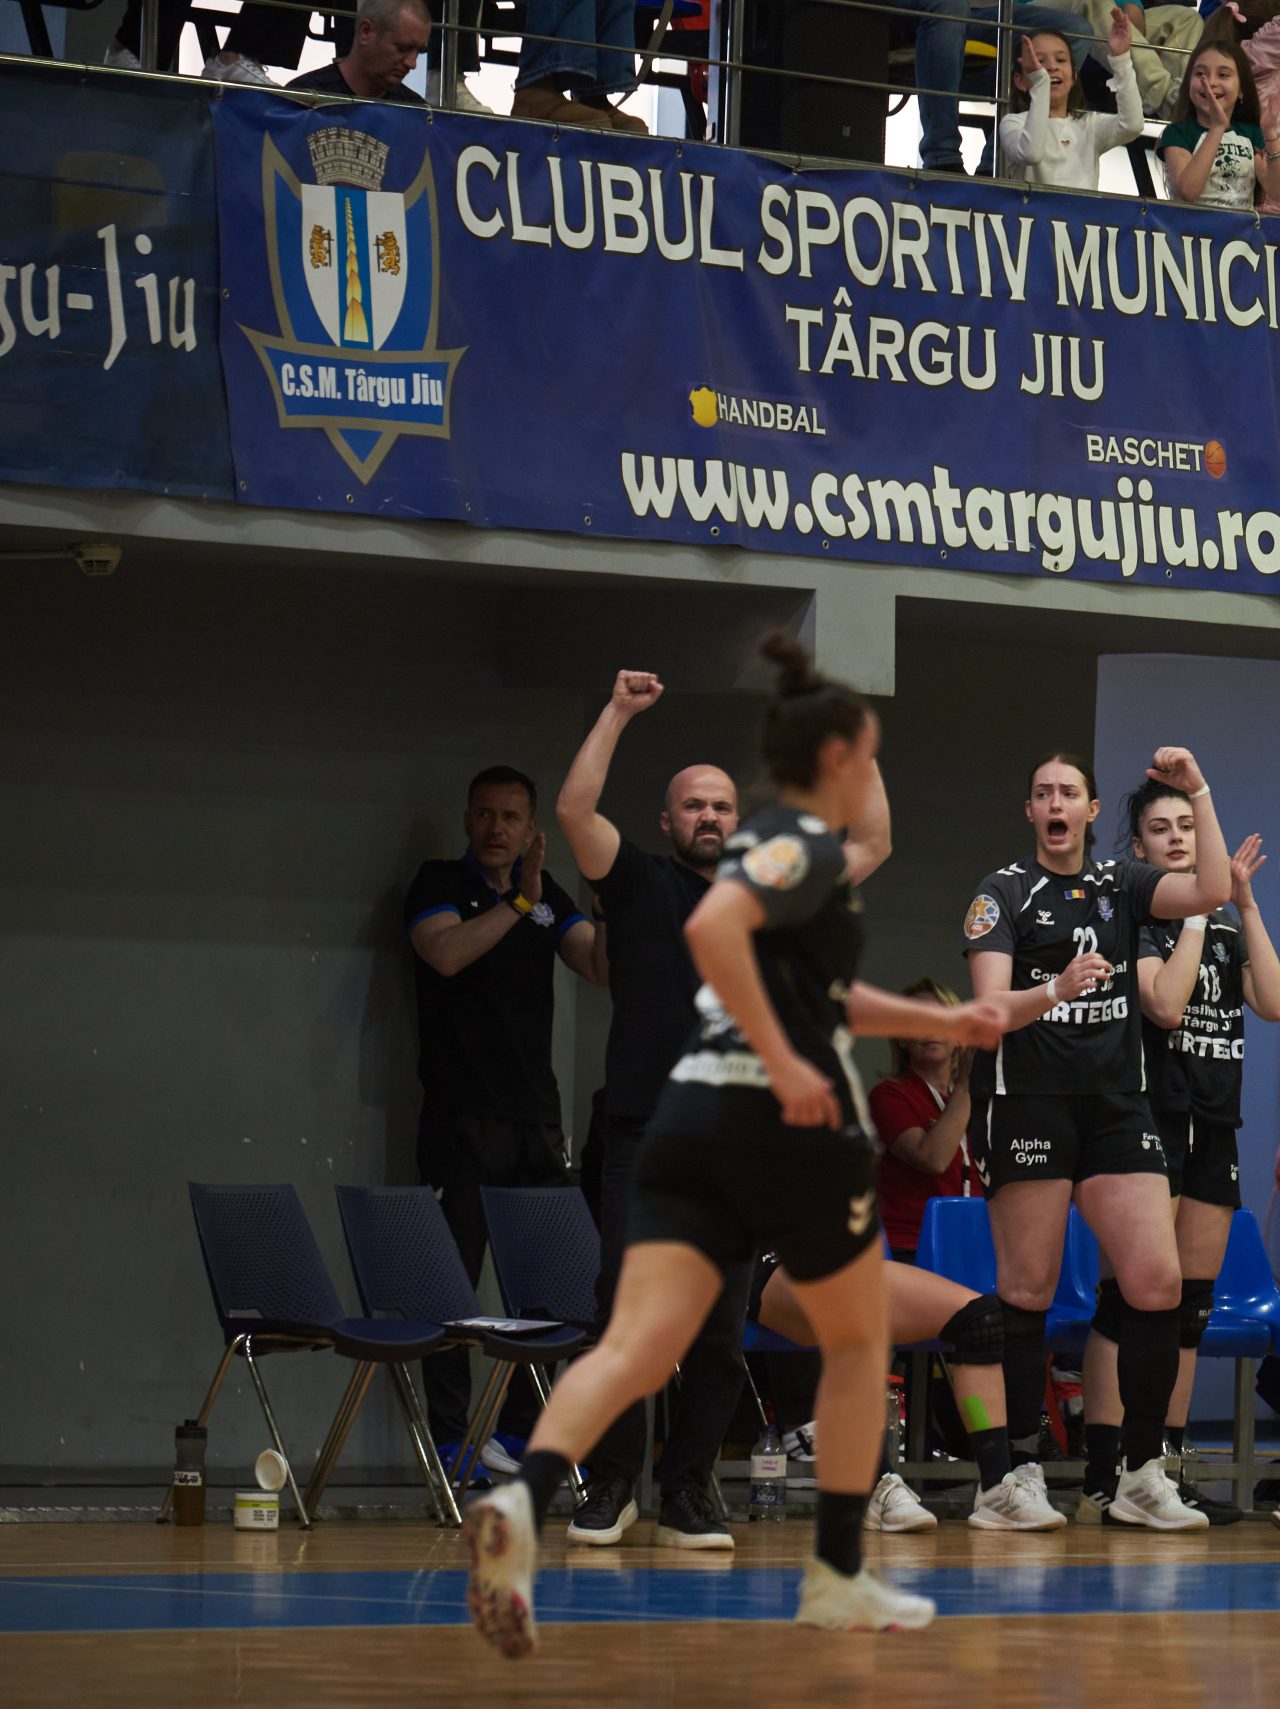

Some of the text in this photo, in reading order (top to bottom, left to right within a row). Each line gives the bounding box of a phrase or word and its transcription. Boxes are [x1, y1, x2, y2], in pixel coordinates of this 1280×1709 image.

[455, 145, 744, 272] CLUBUL
[758, 184, 1035, 302] SPORTIV
[785, 286, 1105, 401] TÂRGU JIU
[281, 362, 443, 408] C.S.M. Târgu Jiu
[717, 393, 826, 435] HANDBAL
[1086, 434, 1204, 471] BASCHET
[1010, 1138, 1052, 1153] Alpha
[1015, 1151, 1048, 1165] Gym
